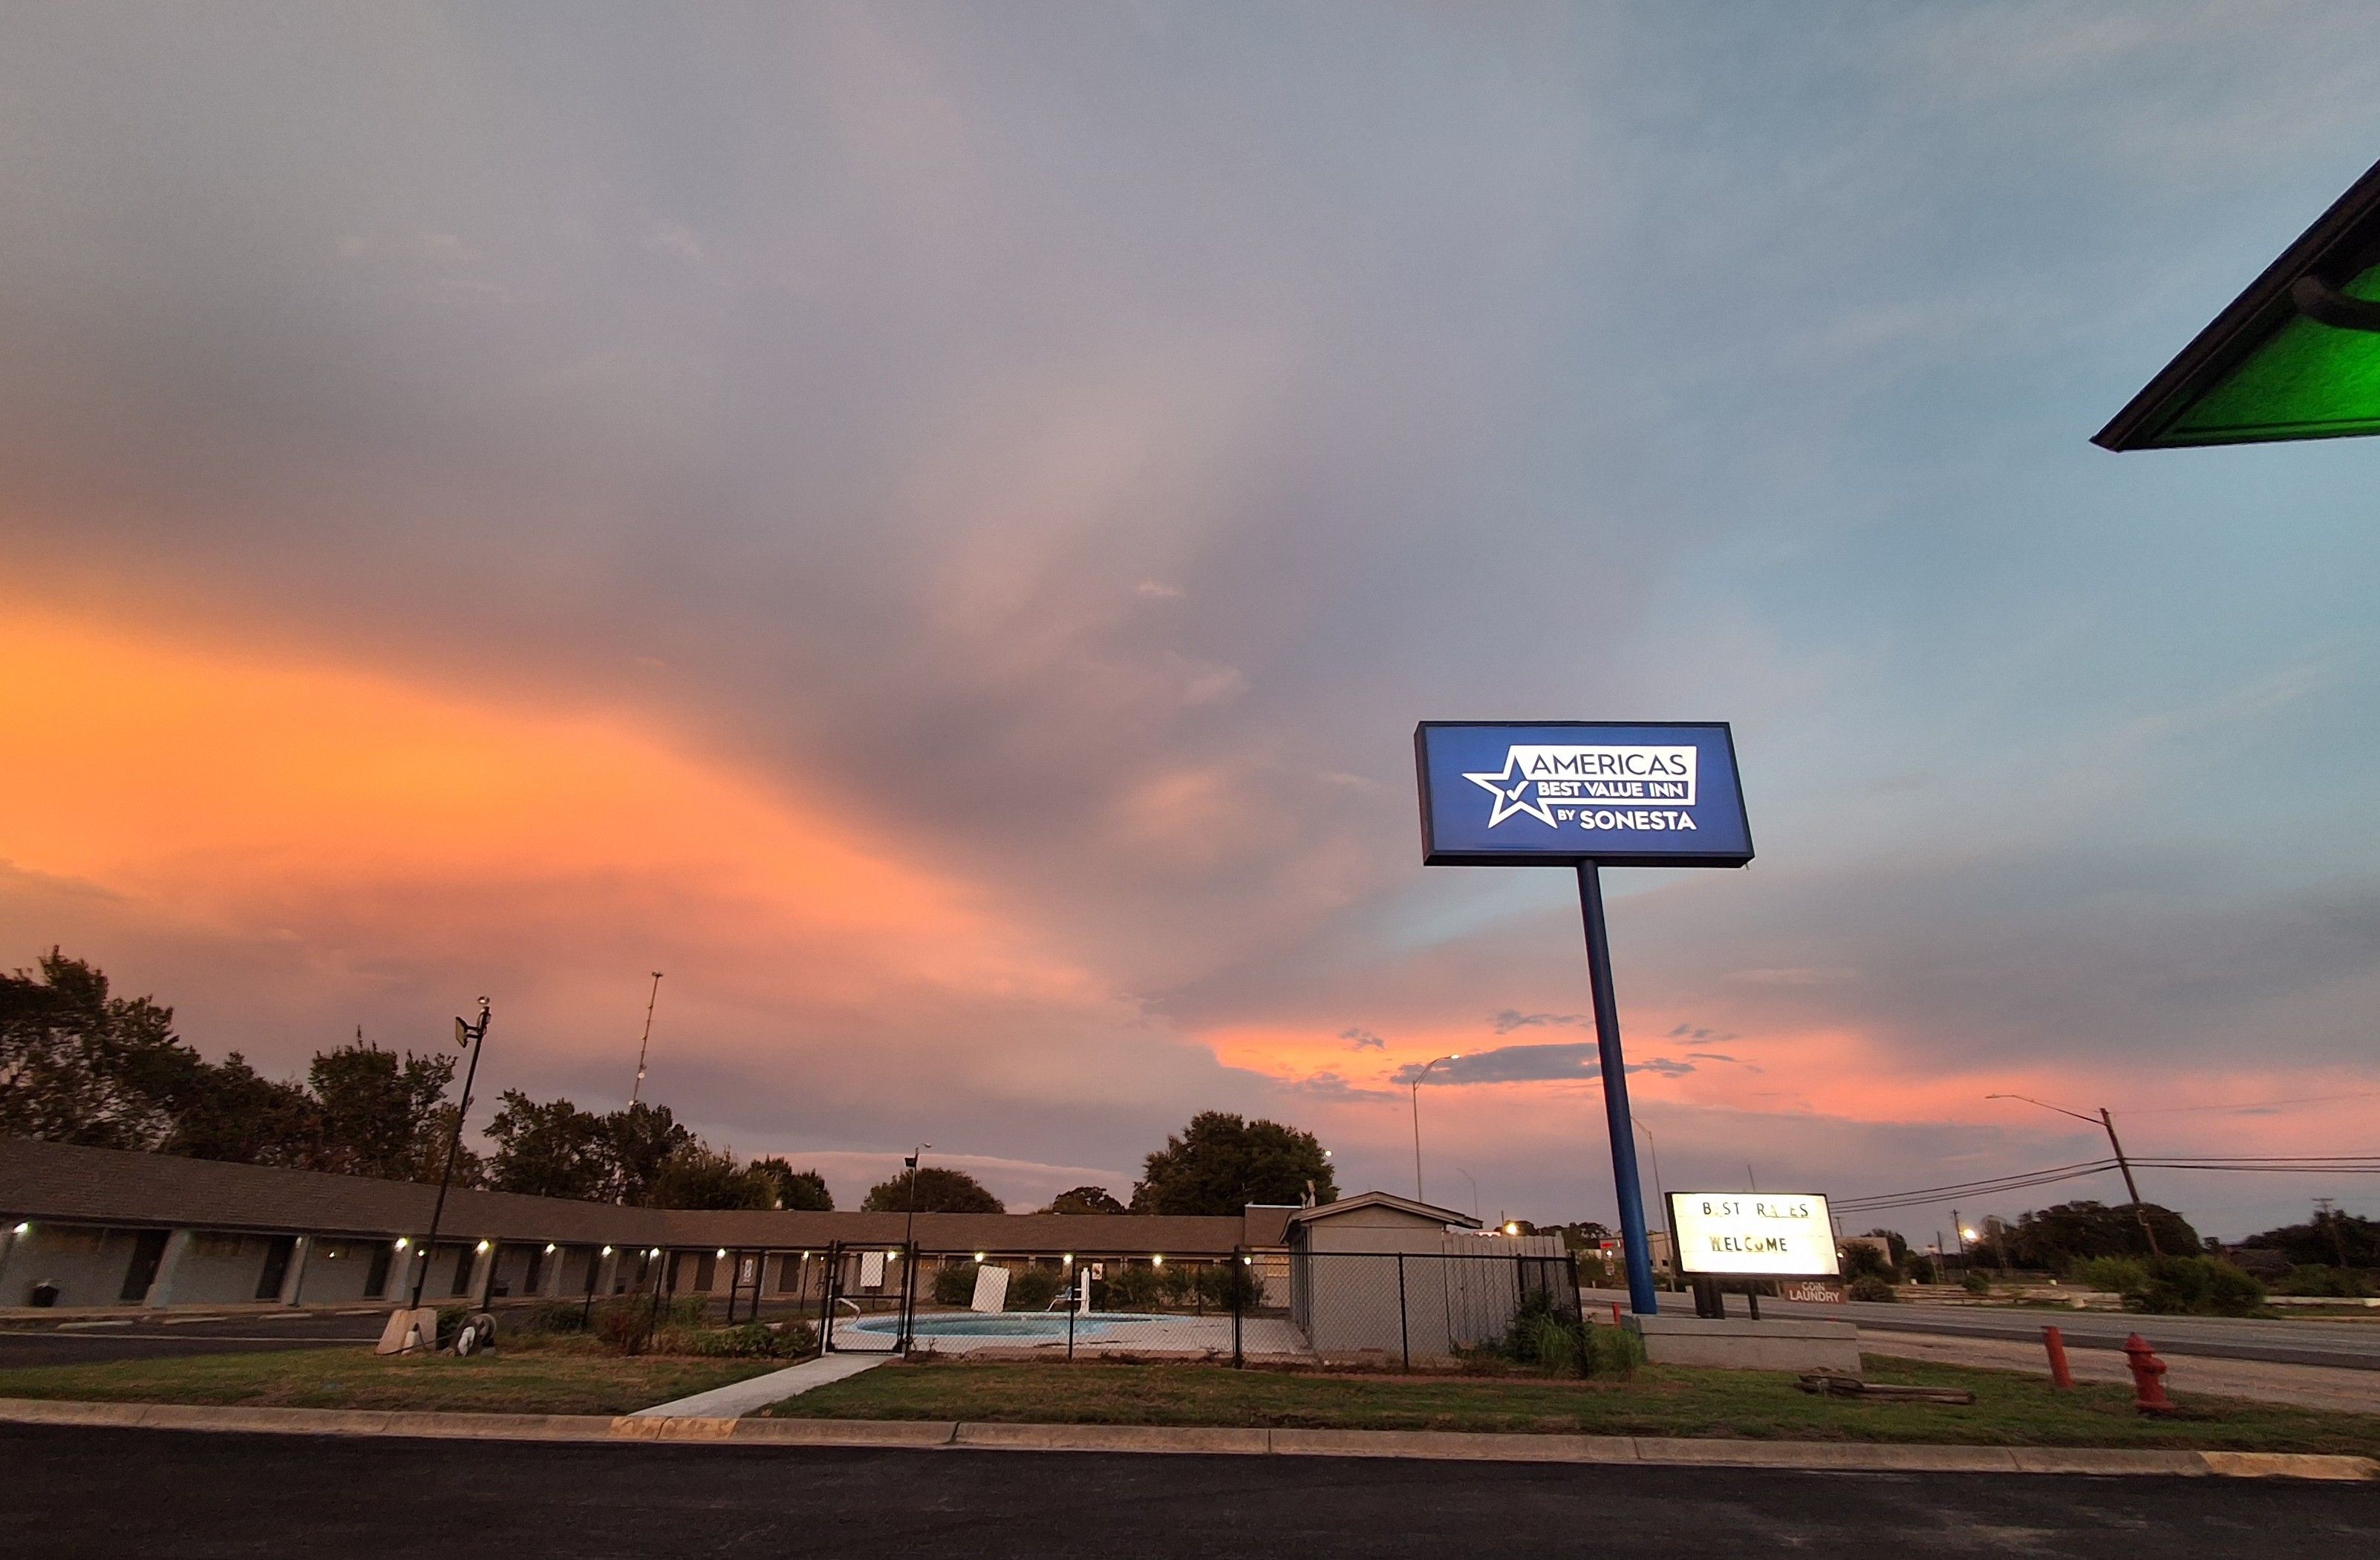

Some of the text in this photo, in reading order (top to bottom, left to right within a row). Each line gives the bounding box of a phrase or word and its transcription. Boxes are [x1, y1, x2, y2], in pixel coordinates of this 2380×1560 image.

[1530, 754, 1687, 775] AMERICAS
[1538, 782, 1684, 797] BEST VALUE INN
[1557, 809, 1697, 831] BY SONESTA
[1703, 1201, 1740, 1215] BST
[1802, 1282, 1825, 1291] COIN
[1789, 1290, 1839, 1302] LAUNDRY
